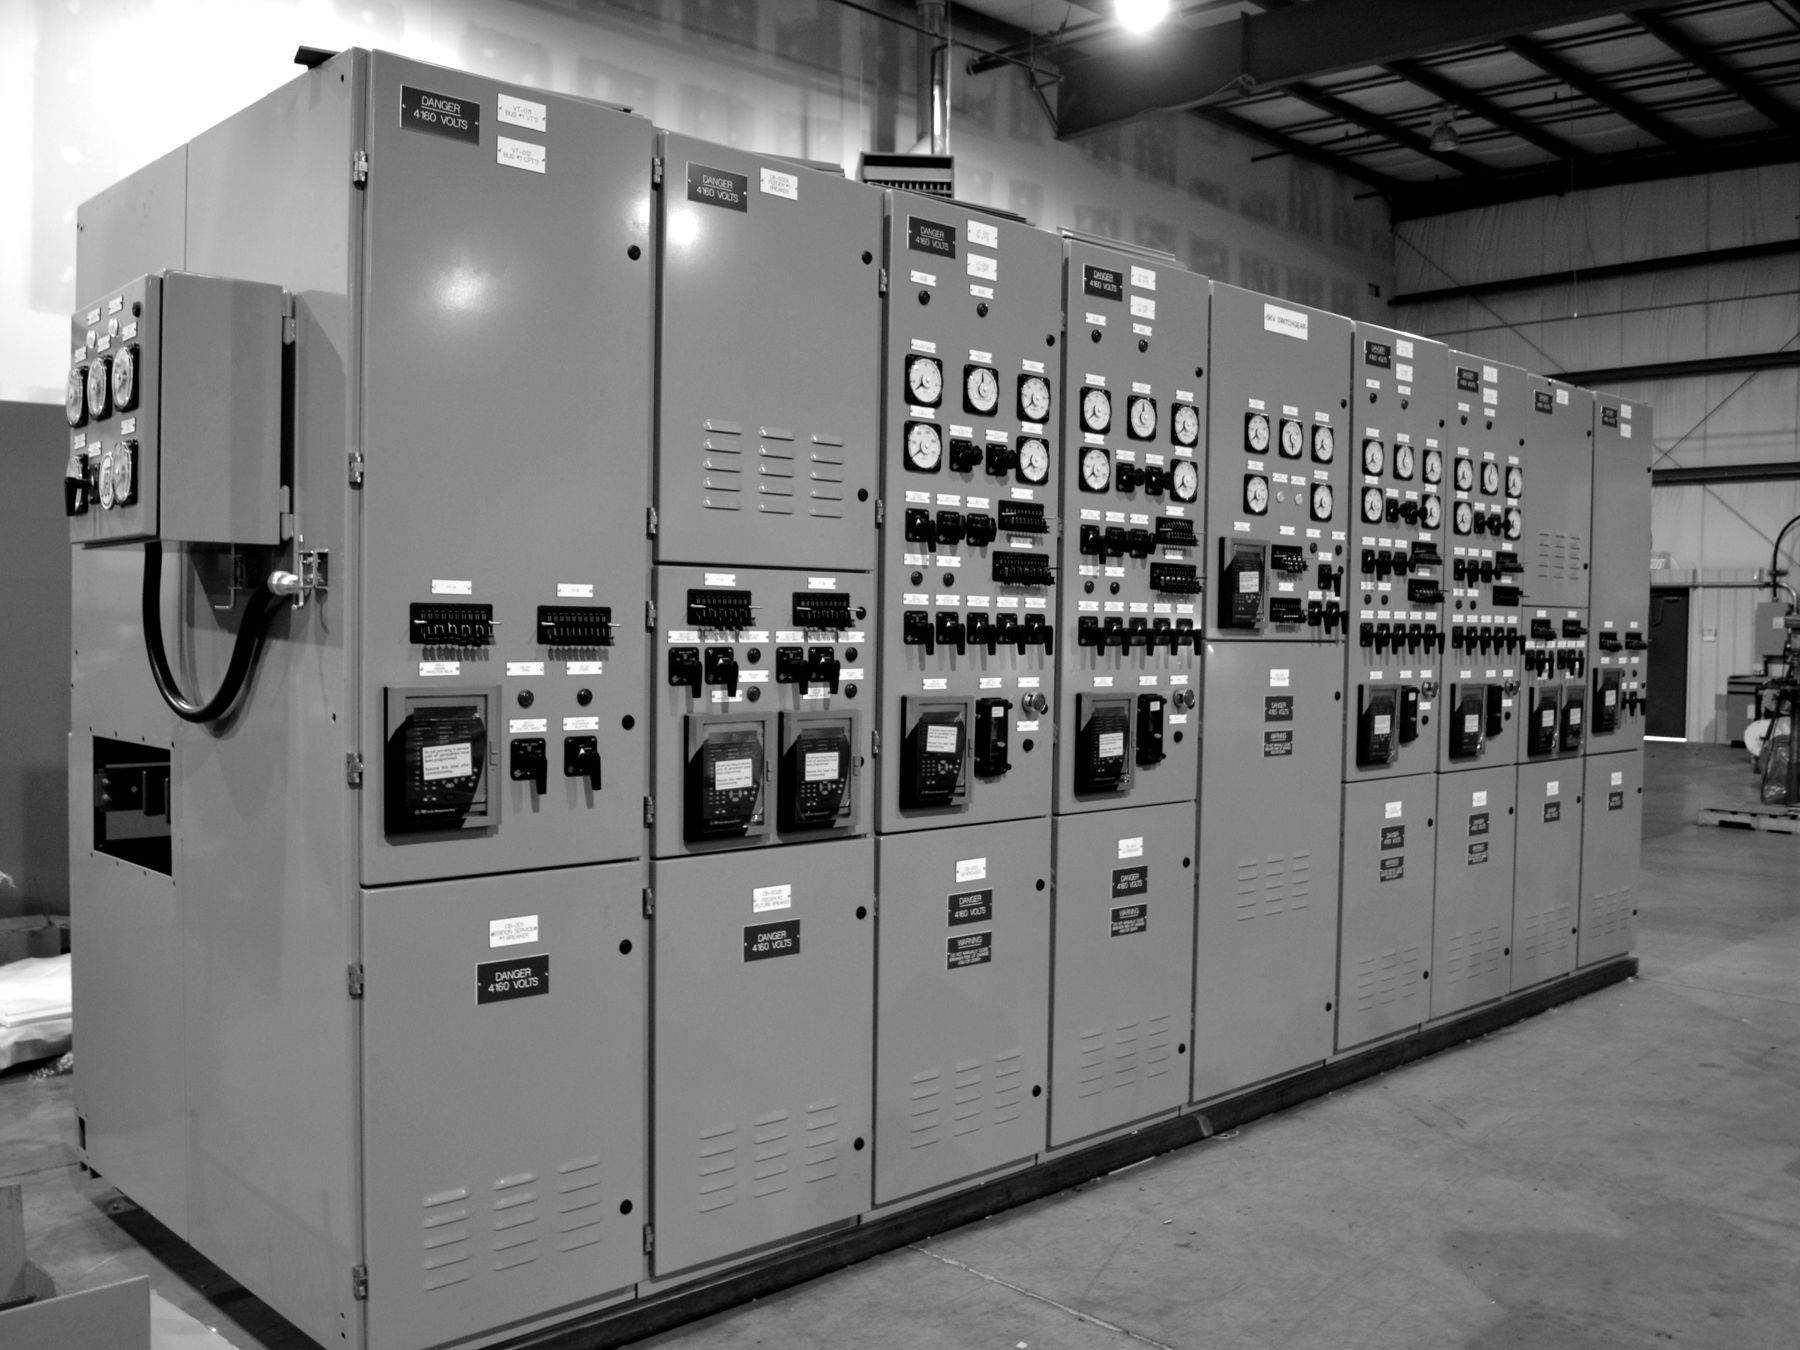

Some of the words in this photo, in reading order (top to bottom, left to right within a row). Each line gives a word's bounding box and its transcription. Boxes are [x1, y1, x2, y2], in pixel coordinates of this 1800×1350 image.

[421, 95, 461, 114] DANGER
[413, 109, 437, 123] 4160
[440, 115, 468, 130] VOLTS
[702, 174, 734, 190] DANGER
[696, 186, 715, 198] 4160
[717, 190, 739, 203] VOLTS
[920, 226, 945, 239] DANGER
[915, 236, 930, 247] 4160
[931, 240, 949, 251] VOLTS
[1093, 270, 1114, 282] DANGER
[1277, 316, 1307, 329] SWITCHGEAR
[1120, 873, 1140, 882] DANGER
[959, 894, 982, 905] DANGER
[954, 909, 969, 918] 4160
[970, 906, 987, 916] VOLTS
[757, 930, 787, 943] DANGER
[957, 936, 982, 947] WARNING
[752, 942, 770, 952] 4160
[771, 938, 792, 949] VOLTS
[495, 967, 532, 982] DANGER
[487, 981, 511, 993] 4160
[513, 976, 539, 989] VOLTS
